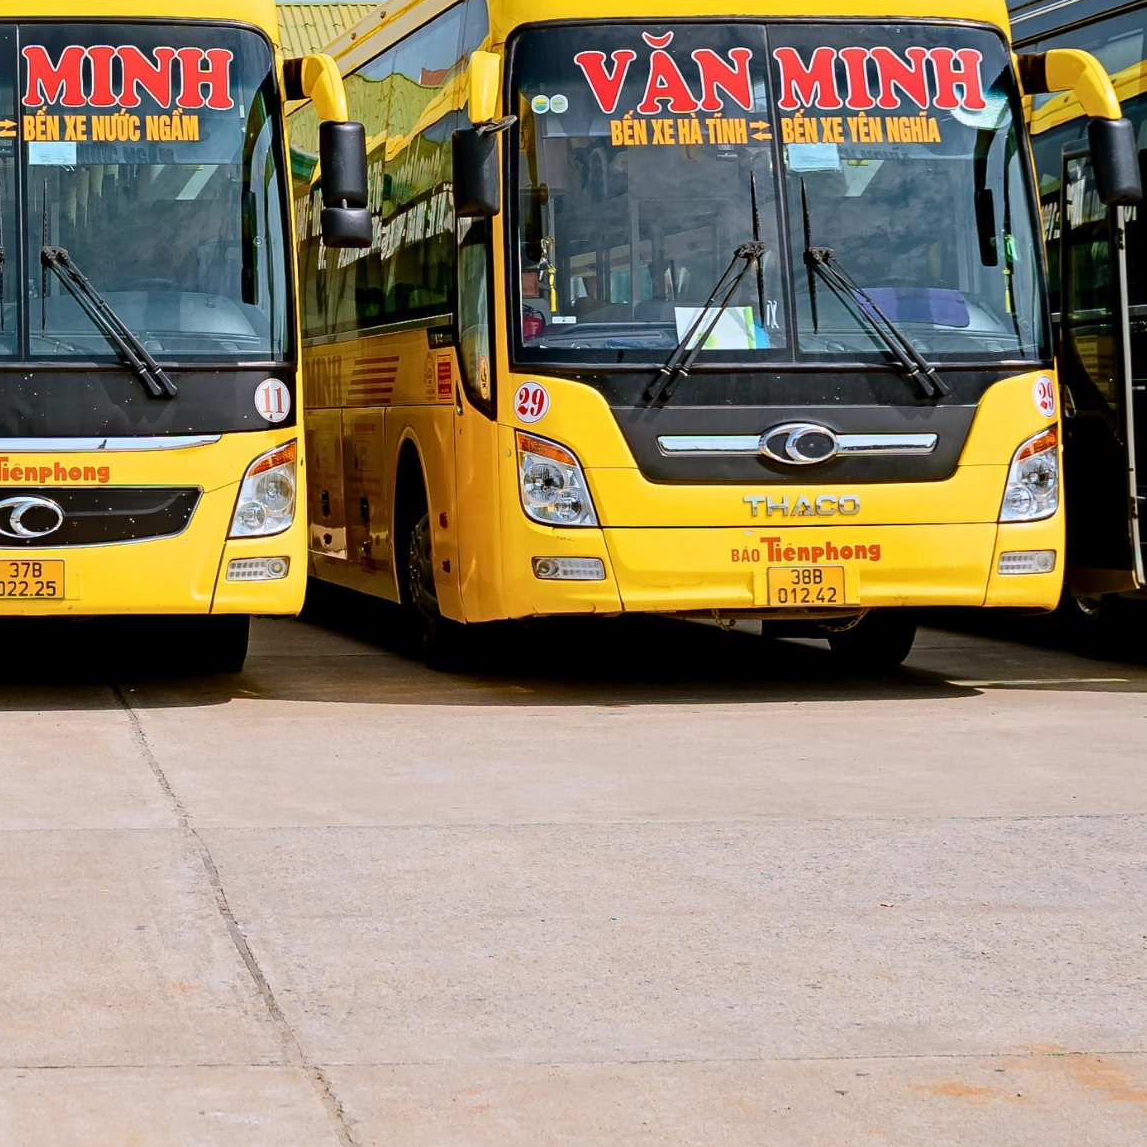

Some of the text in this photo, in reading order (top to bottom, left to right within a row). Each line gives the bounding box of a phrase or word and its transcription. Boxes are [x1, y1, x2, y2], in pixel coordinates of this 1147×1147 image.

[21, 45, 234, 110] MINH
[574, 31, 987, 114] VĂN MINH
[23, 106, 60, 142] BẾN
[63, 115, 87, 141] XE
[91, 108, 141, 142] NƯỚC
[145, 107, 199, 142] NGẦM
[610, 108, 941, 146] BẾN XE HÀ TĨNH BẾN XE YÊN NGHĨA
[261, 385, 285, 414] 11
[516, 386, 546, 417] 29
[743, 495, 861, 517] THACO
[730, 545, 761, 563] BÁO
[9, 562, 42, 578] 37B
[790, 568, 823, 585] 38B
[777, 587, 838, 604] 012.42
